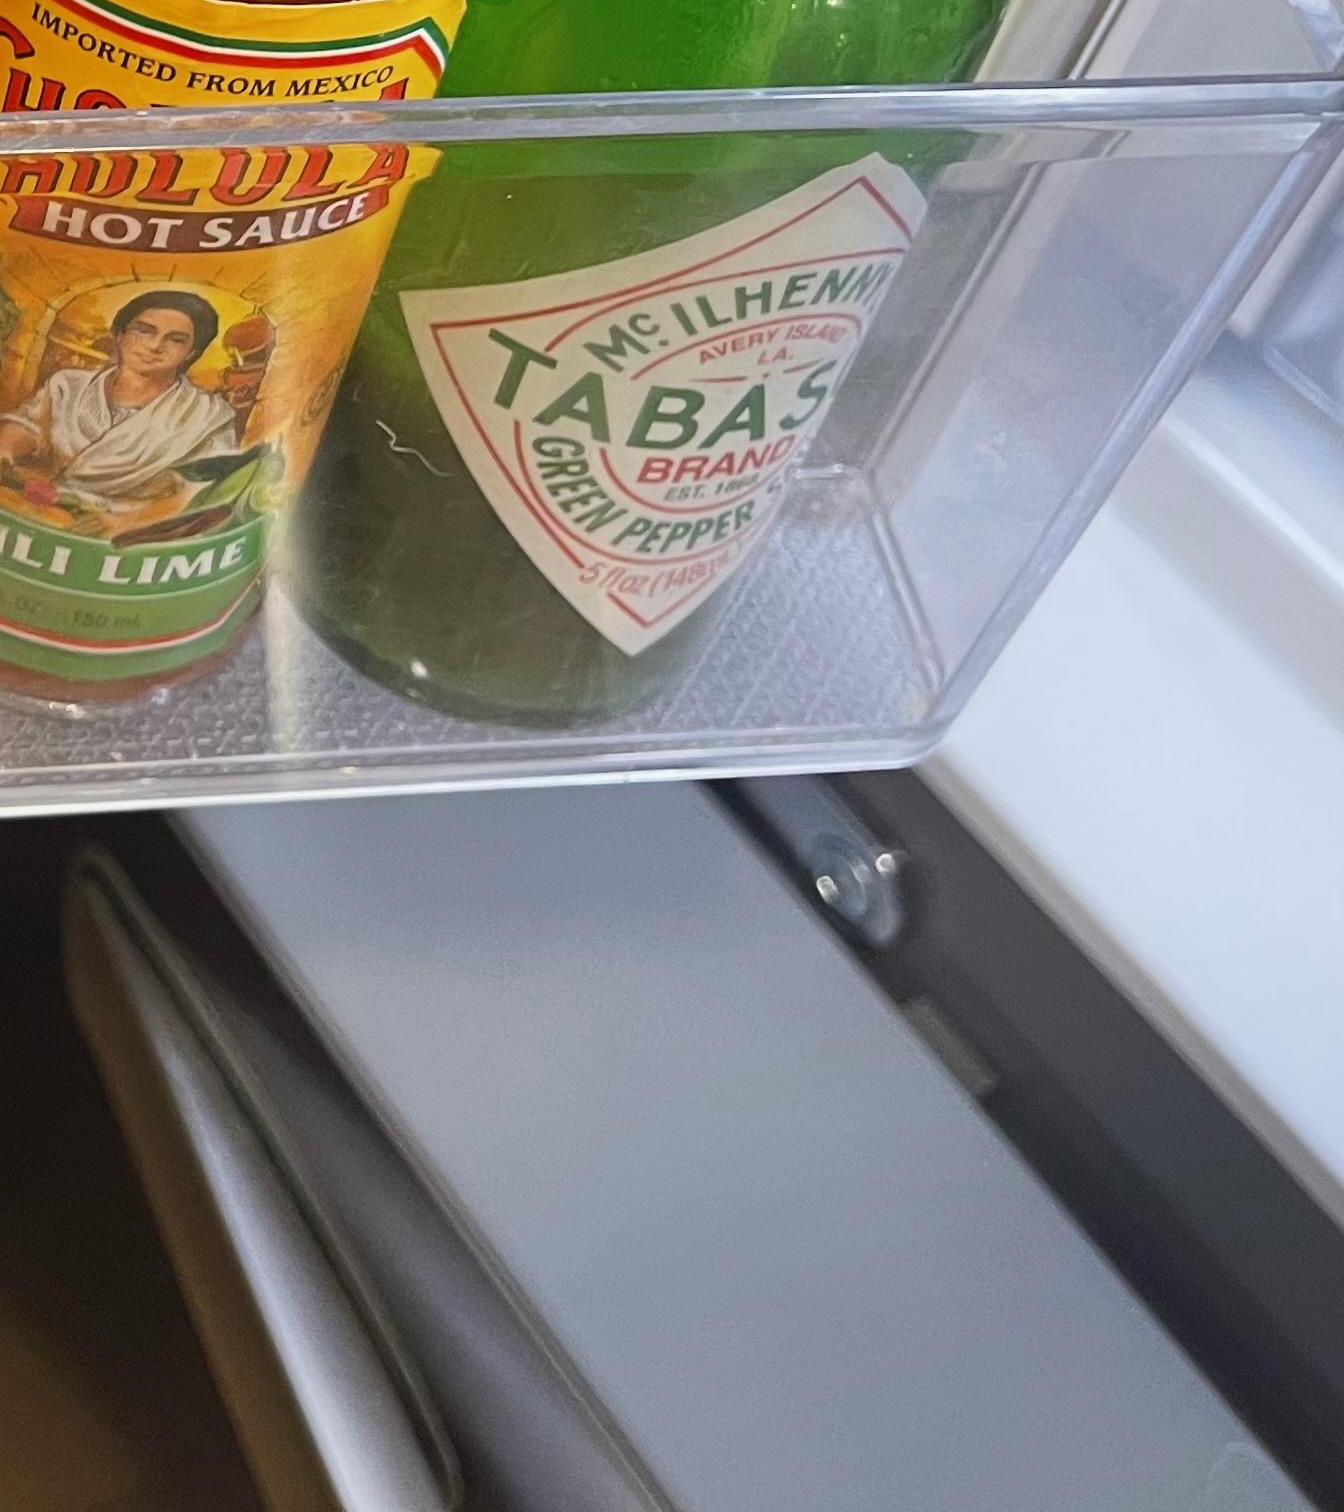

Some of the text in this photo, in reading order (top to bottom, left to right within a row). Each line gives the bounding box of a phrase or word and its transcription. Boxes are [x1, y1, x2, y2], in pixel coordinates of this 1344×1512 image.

[32, 2, 394, 97] IMPORTED FROM MEXICO
[41, 191, 370, 249] HOT SAUCE
[699, 328, 780, 364] AVERY
[637, 434, 797, 485] BRAND
[532, 437, 757, 556] GREEN PEPPER
[98, 537, 248, 585] LIME
